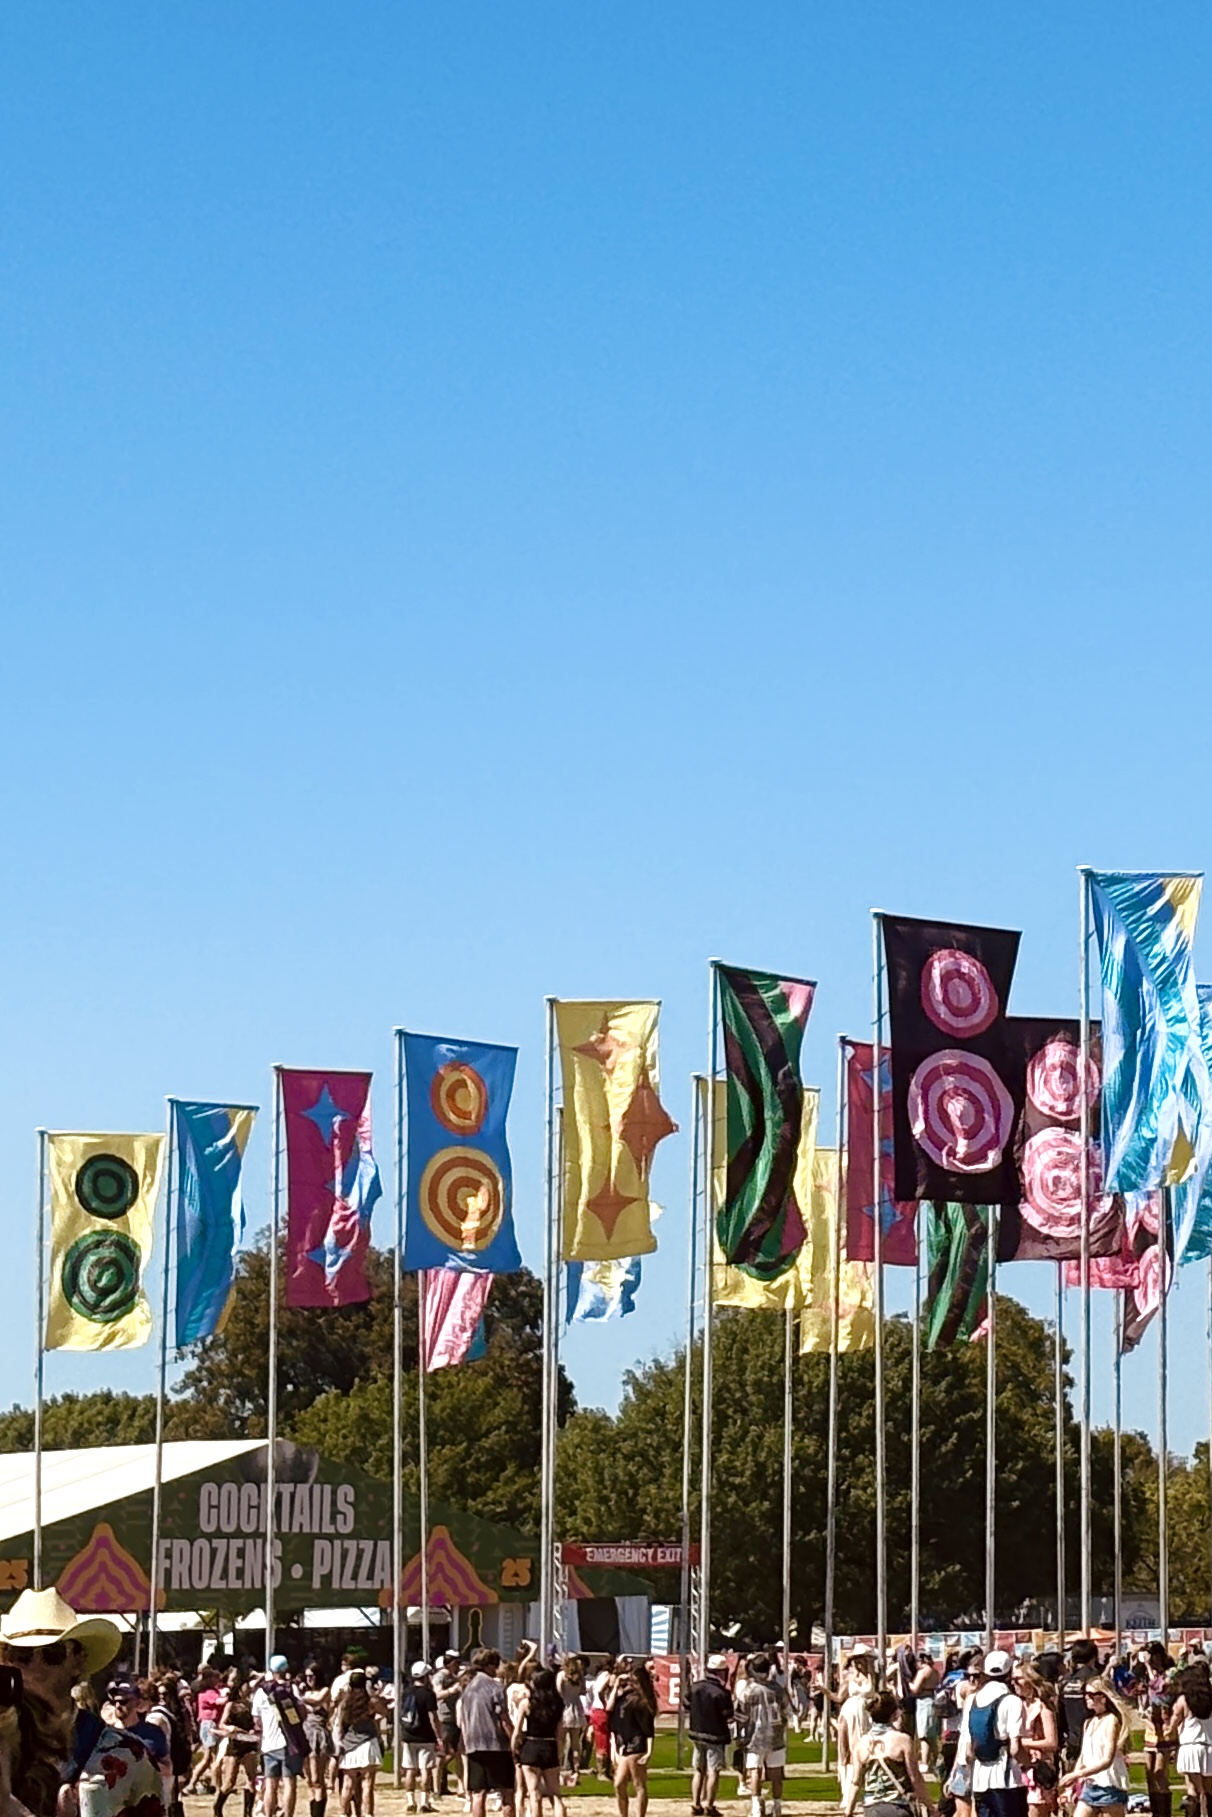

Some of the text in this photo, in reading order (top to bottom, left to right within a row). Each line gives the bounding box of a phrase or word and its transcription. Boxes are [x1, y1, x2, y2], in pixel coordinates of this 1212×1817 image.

[200, 1482, 355, 1534] COCKTAILS
[157, 1538, 392, 1589] FROZENS PIZZA
[501, 1558, 531, 1587] 25
[586, 1547, 682, 1563] EMERGENCY EXIT
